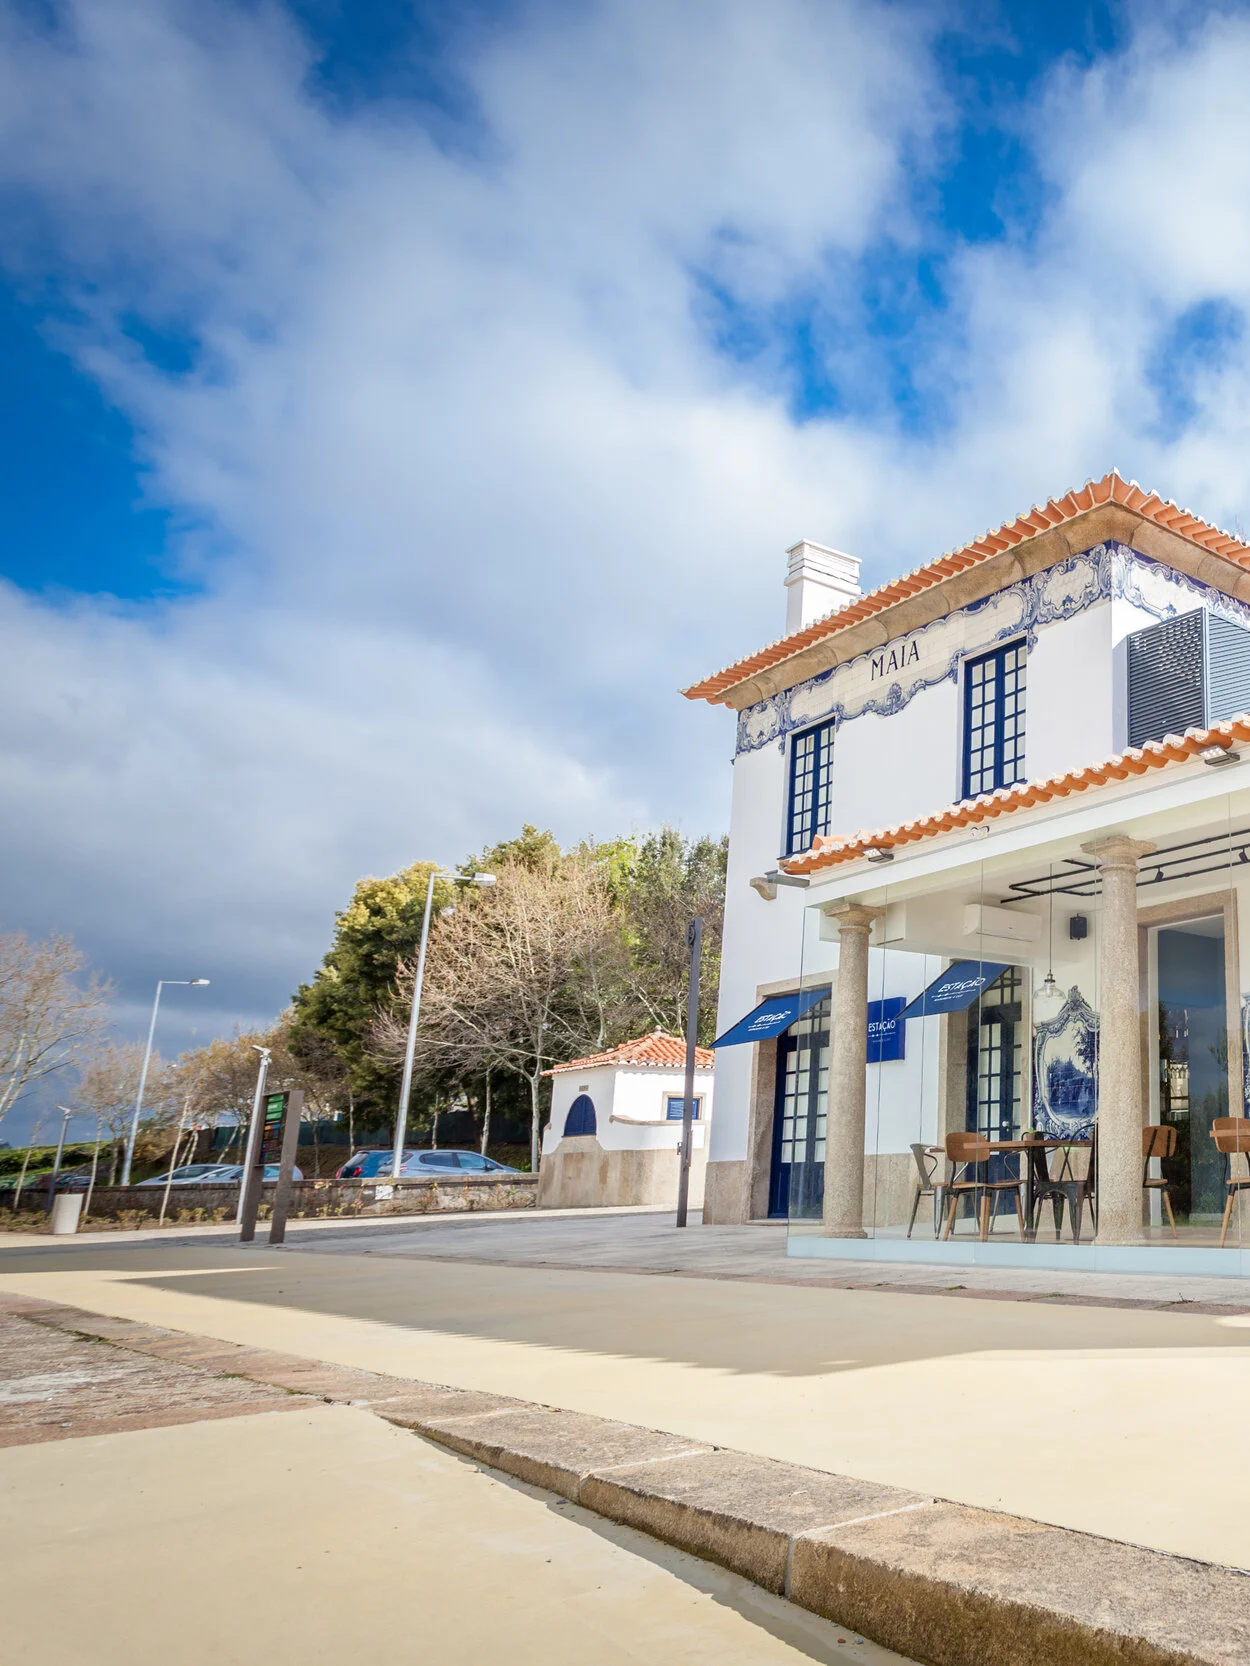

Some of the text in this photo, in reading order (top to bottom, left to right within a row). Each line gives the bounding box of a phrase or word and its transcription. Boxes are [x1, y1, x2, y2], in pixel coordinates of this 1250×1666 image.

[871, 640, 920, 681] MAIA
[938, 976, 986, 992] ESTAÇÃO
[868, 1018, 896, 1032] ESTAÇÃO
